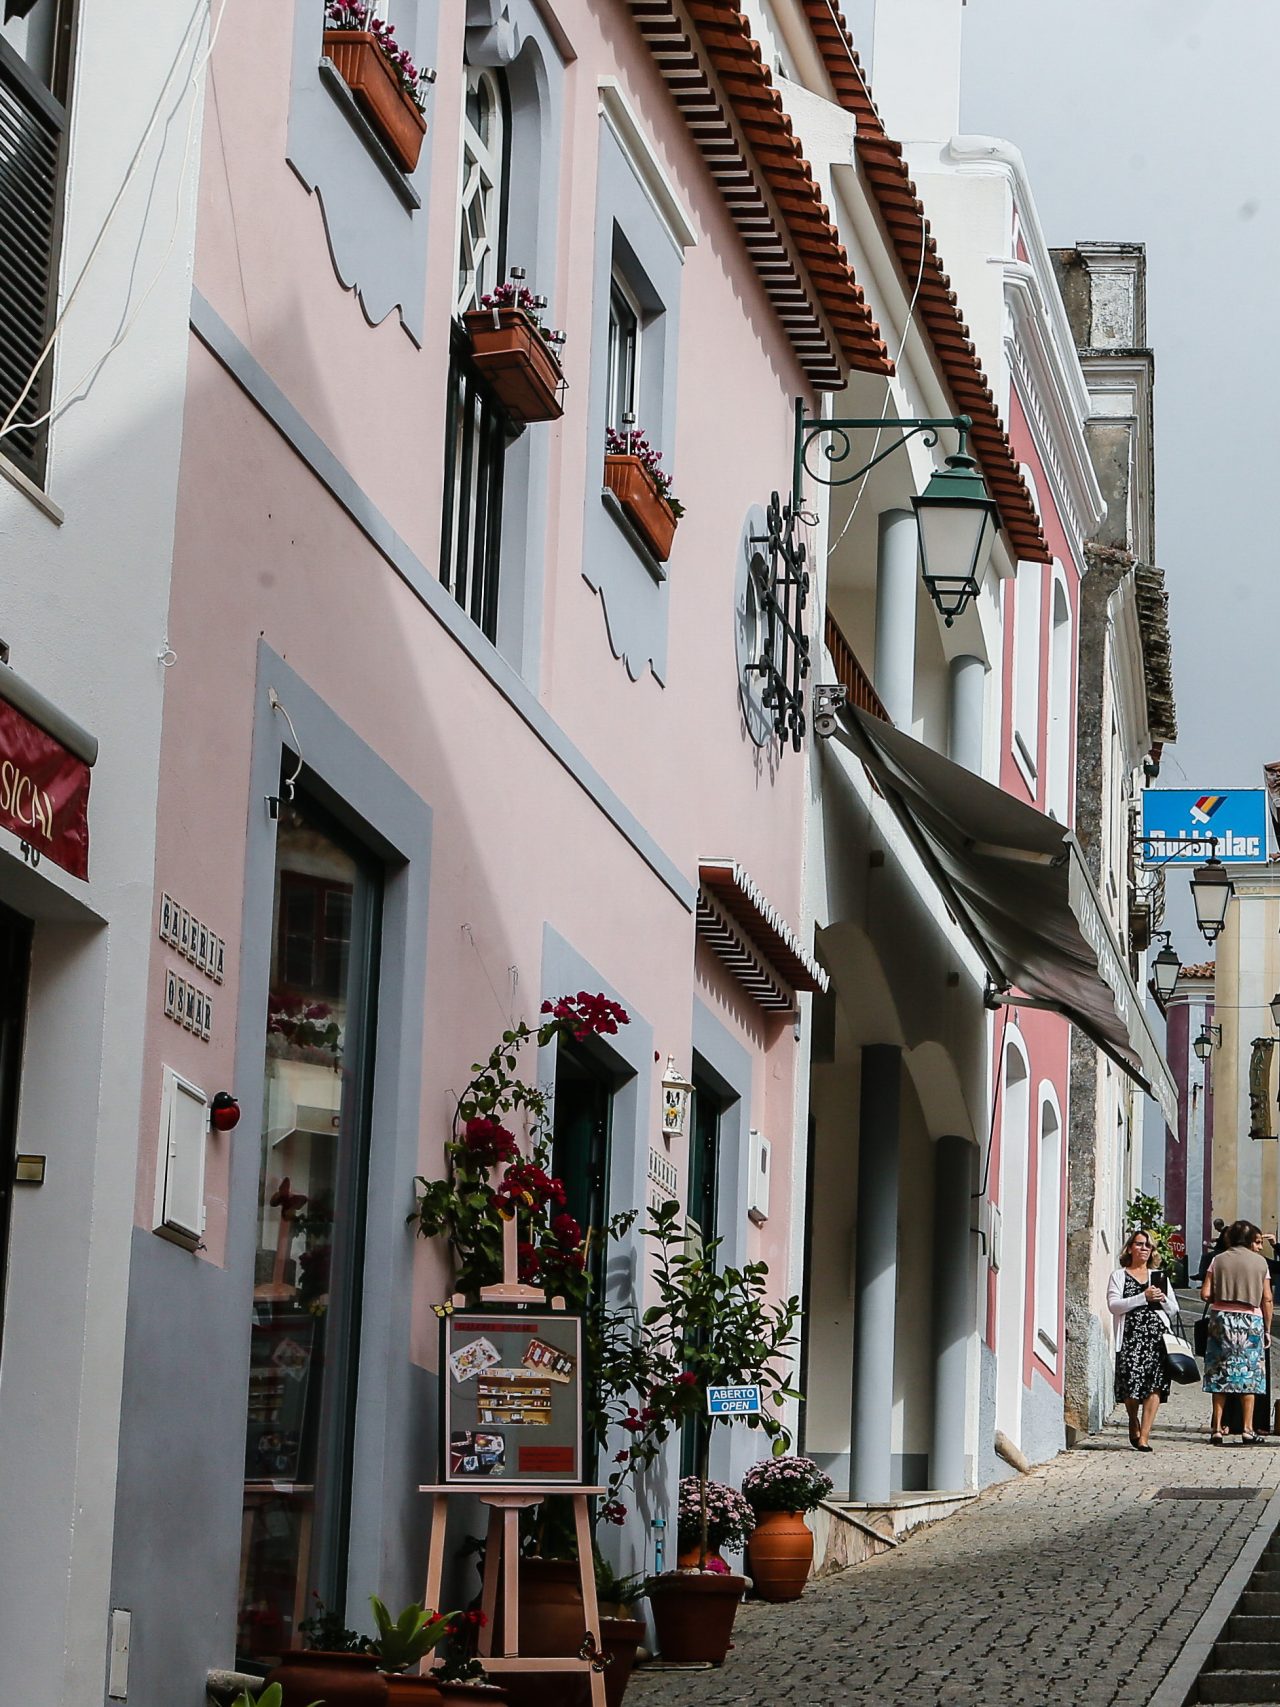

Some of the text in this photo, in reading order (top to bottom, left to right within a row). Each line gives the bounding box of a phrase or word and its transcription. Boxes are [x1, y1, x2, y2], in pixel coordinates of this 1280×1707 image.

[162, 903, 225, 975] GALERIA
[168, 979, 212, 1030] OSMAR
[1167, 1242, 1185, 1252] STOP
[713, 1389, 755, 1400] ABERTO
[721, 1401, 750, 1411] OPEN
